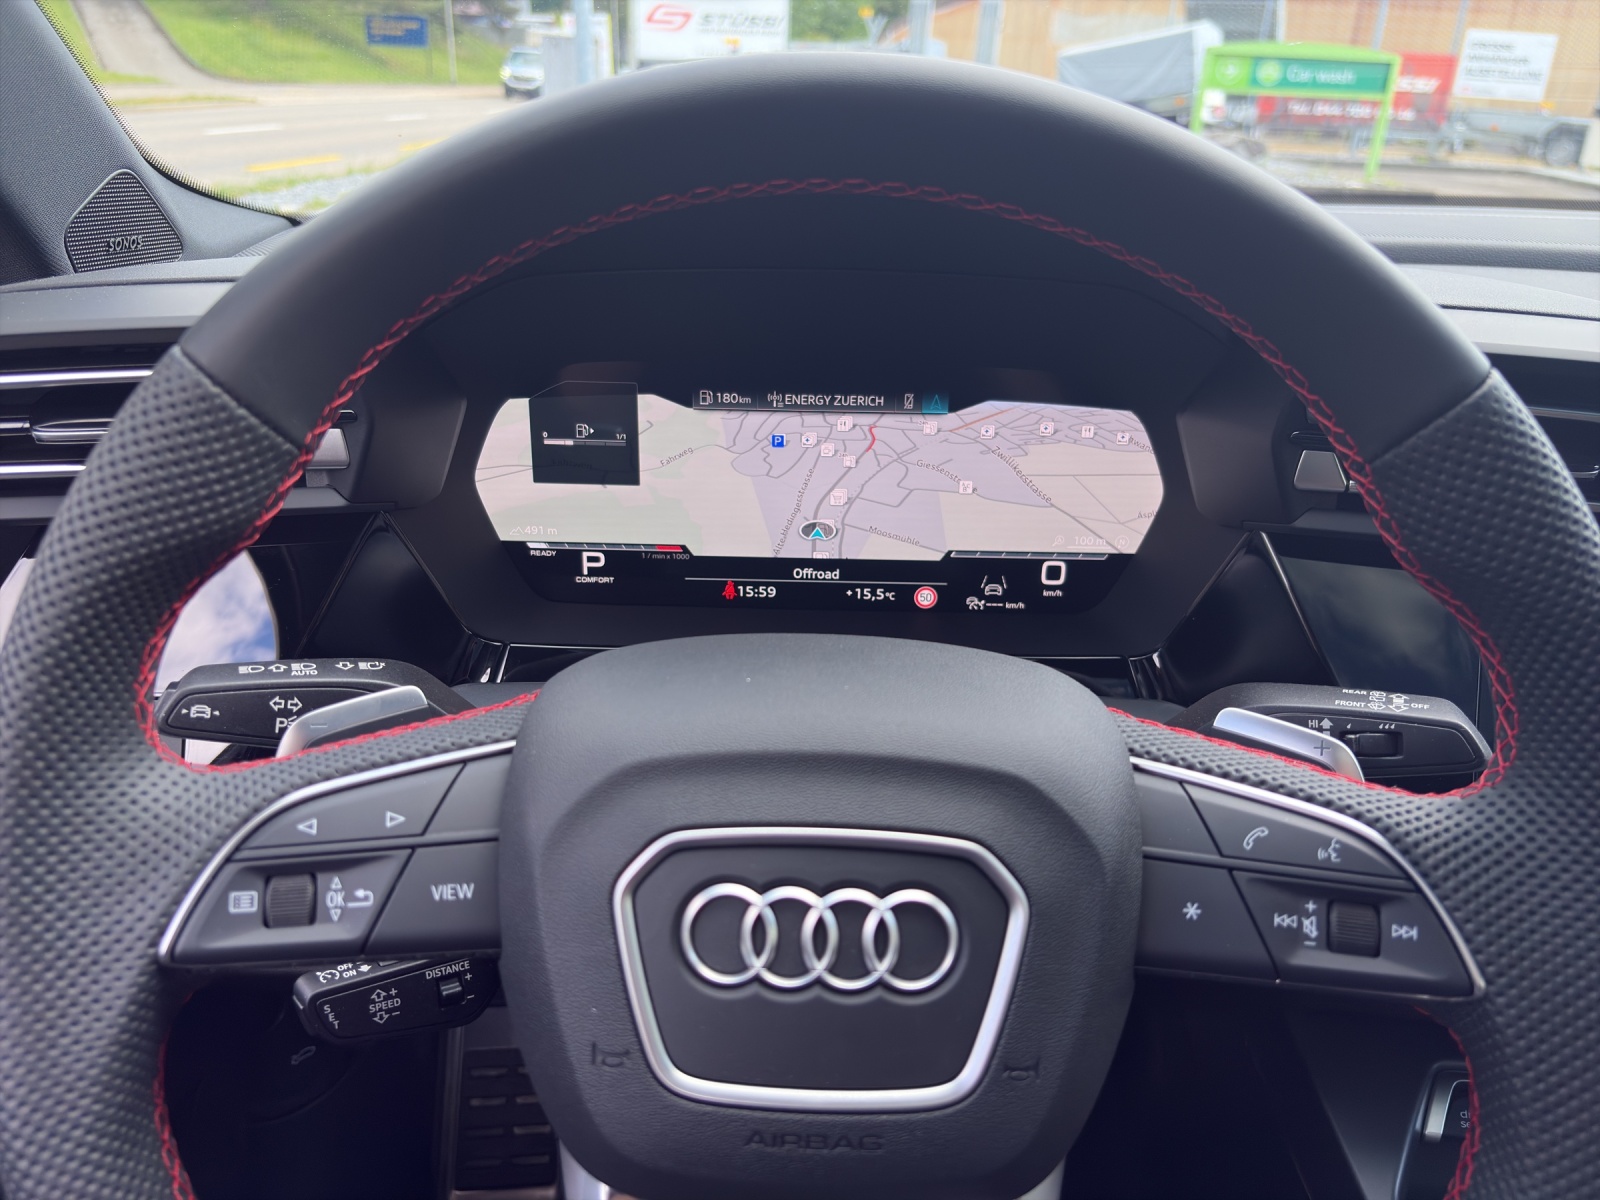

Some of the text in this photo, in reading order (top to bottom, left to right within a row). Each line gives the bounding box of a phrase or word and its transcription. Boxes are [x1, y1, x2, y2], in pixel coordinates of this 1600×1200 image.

[109, 235, 143, 251] SONOS
[785, 394, 884, 407] ENERGY ZUERICH
[660, 446, 694, 467] Fahrweg
[991, 445, 1052, 504] Zwillikerstrasse
[524, 526, 544, 535] 491
[868, 525, 920, 547] Moosmühle
[1074, 536, 1098, 545] 100
[581, 551, 606, 576] P
[575, 576, 615, 584] COMFORT
[793, 567, 840, 580] Offroad
[737, 585, 776, 598] 15:59
[919, 592, 932, 603] 50
[1043, 589, 1063, 598] km/h
[1005, 601, 1025, 610] km/h
[1342, 688, 1367, 696] REAR
[1335, 699, 1430, 710] FRONT OFF
[1308, 719, 1319, 729] HI
[326, 890, 345, 907] OK
[430, 882, 475, 902] VIEW
[337, 962, 354, 972] OFF
[343, 969, 357, 978] ON
[425, 960, 471, 980] DISTANCE
[368, 997, 401, 1013] SPEED
[743, 1130, 884, 1151] AIRBAG
